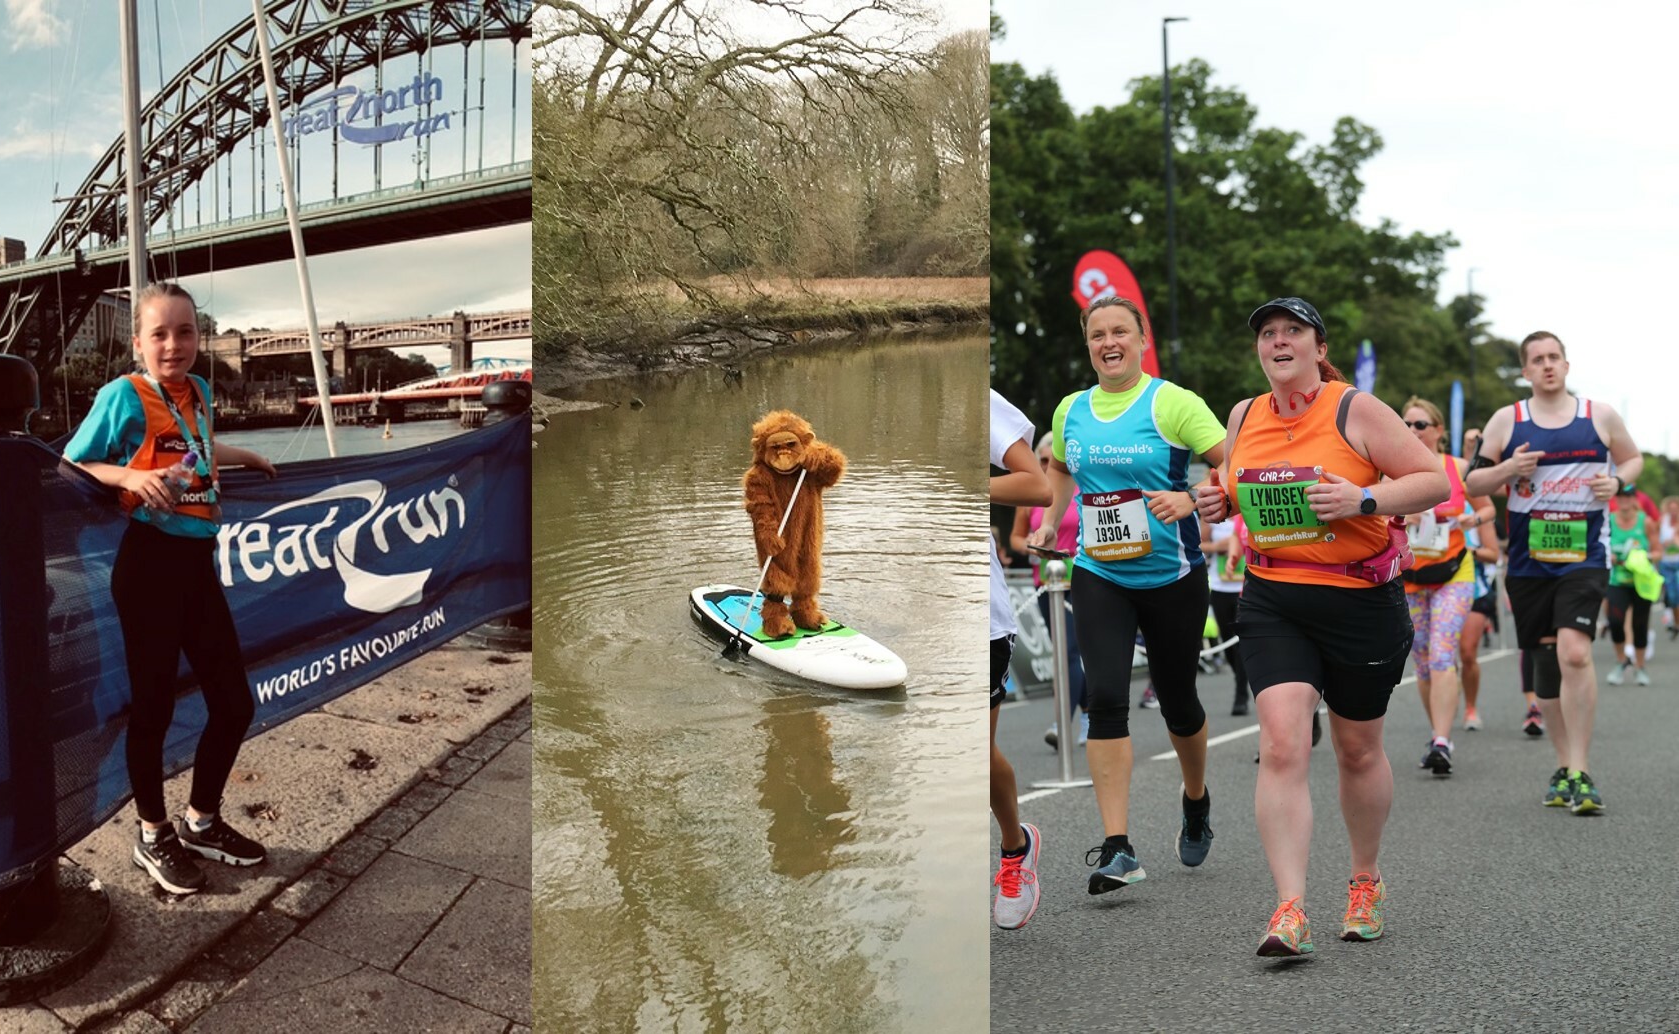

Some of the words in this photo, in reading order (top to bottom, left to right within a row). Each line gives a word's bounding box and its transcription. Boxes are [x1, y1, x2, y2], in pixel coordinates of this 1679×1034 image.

[363, 72, 443, 120] north
[397, 111, 450, 141] run
[1089, 444, 1100, 454] St
[1102, 443, 1154, 454] Oswald's
[1089, 455, 1133, 466] Hospice
[1250, 486, 1305, 507] LYNDSEY
[372, 487, 465, 553] run
[1097, 508, 1121, 525] AINE
[1259, 507, 1304, 527] 50510
[1095, 525, 1131, 543] 19304
[1141, 532, 1149, 541] 10
[1254, 531, 1318, 543] #GreatNorthRun
[1544, 523, 1571, 535] ADAM
[1092, 546, 1143, 557] #GreatNorthRun
[256, 653, 336, 704] WORLD'S
[421, 606, 446, 634] RUN
